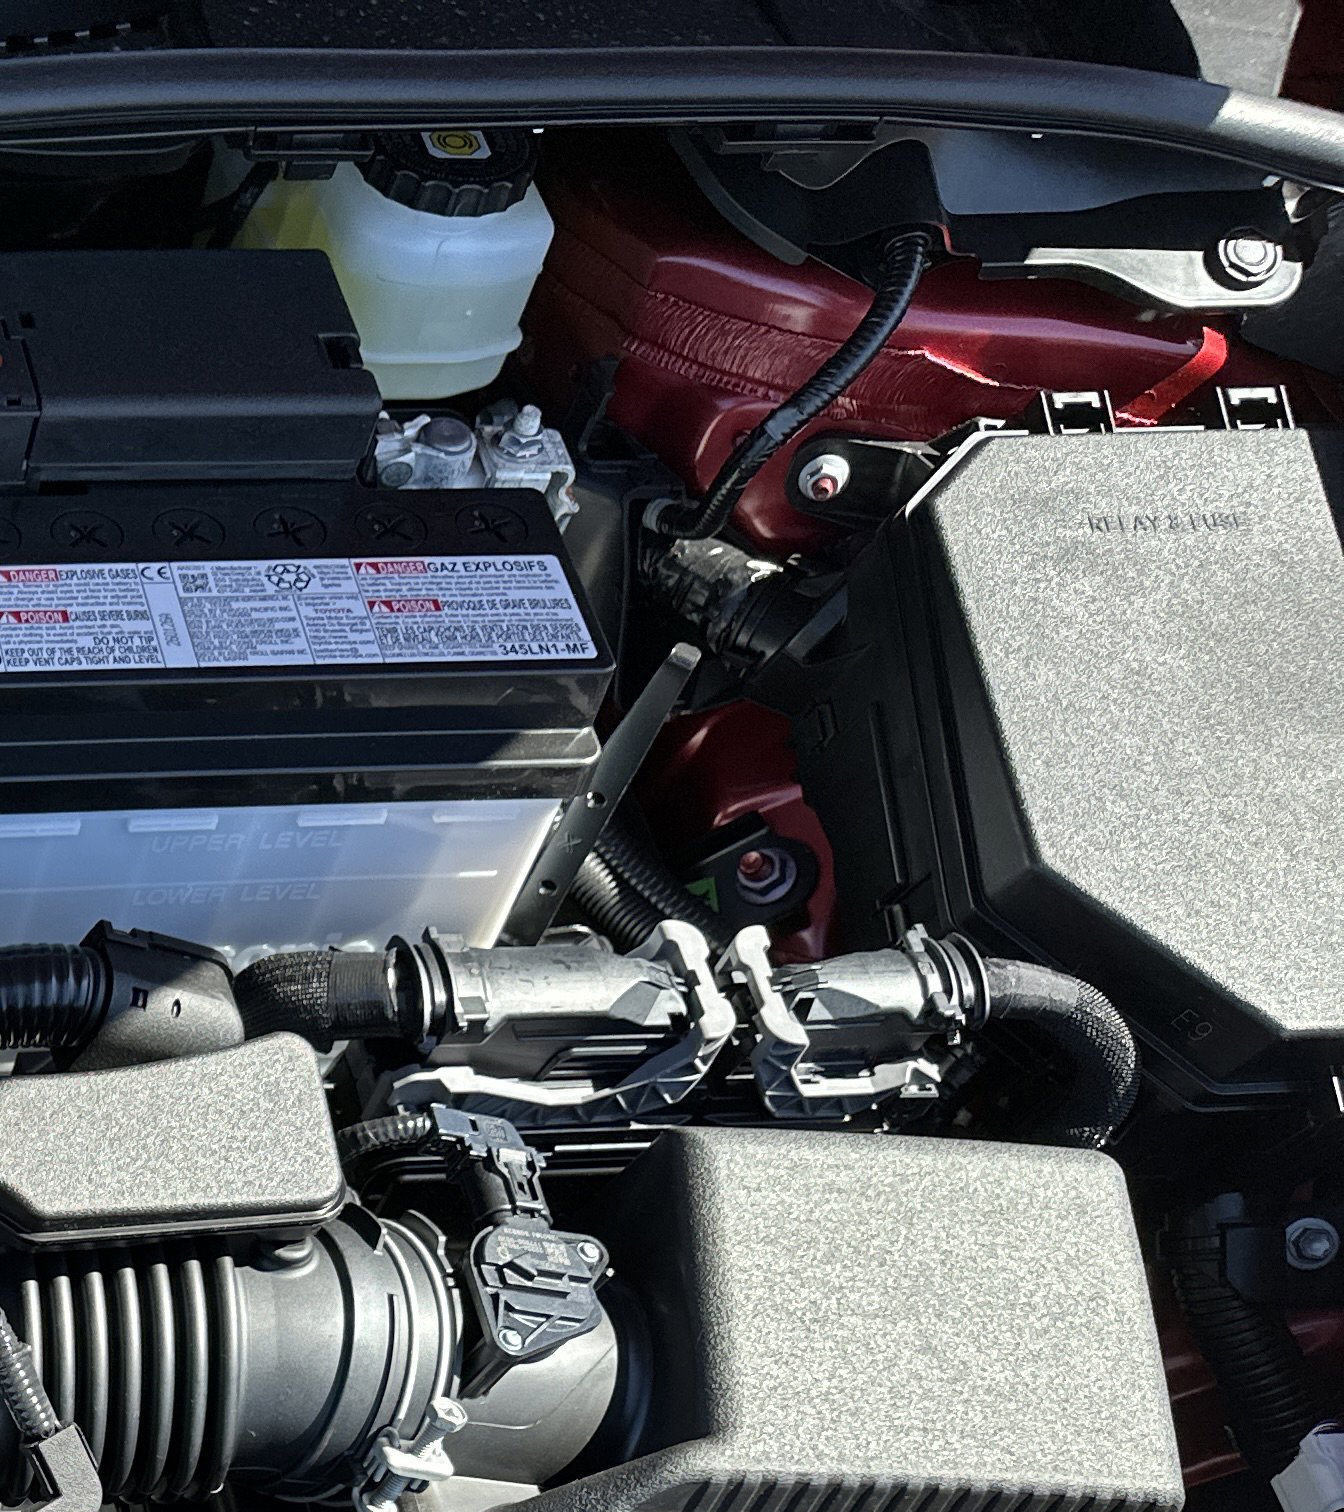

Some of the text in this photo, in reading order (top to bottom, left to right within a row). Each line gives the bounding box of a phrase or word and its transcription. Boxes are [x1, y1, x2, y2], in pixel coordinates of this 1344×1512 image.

[377, 560, 548, 574] DANGER GAZ EXPLOSIFS
[9, 568, 138, 582] DANGER EXPLOSIVE GASES
[391, 600, 437, 612] POISON
[20, 610, 150, 624] POISON CAUSES SEVERE BURNS
[93, 635, 155, 646] DO NOT TIP
[5, 645, 160, 658] KEEP OUT OF THE REACH OF CHILDREN
[498, 642, 591, 656] 345LN1-MF
[7, 654, 162, 667] KEEP VENT CAPS TIGHT AND LEVEL
[150, 829, 344, 853] UPPER LEVEL
[131, 881, 322, 906] LOWER LEVEL
